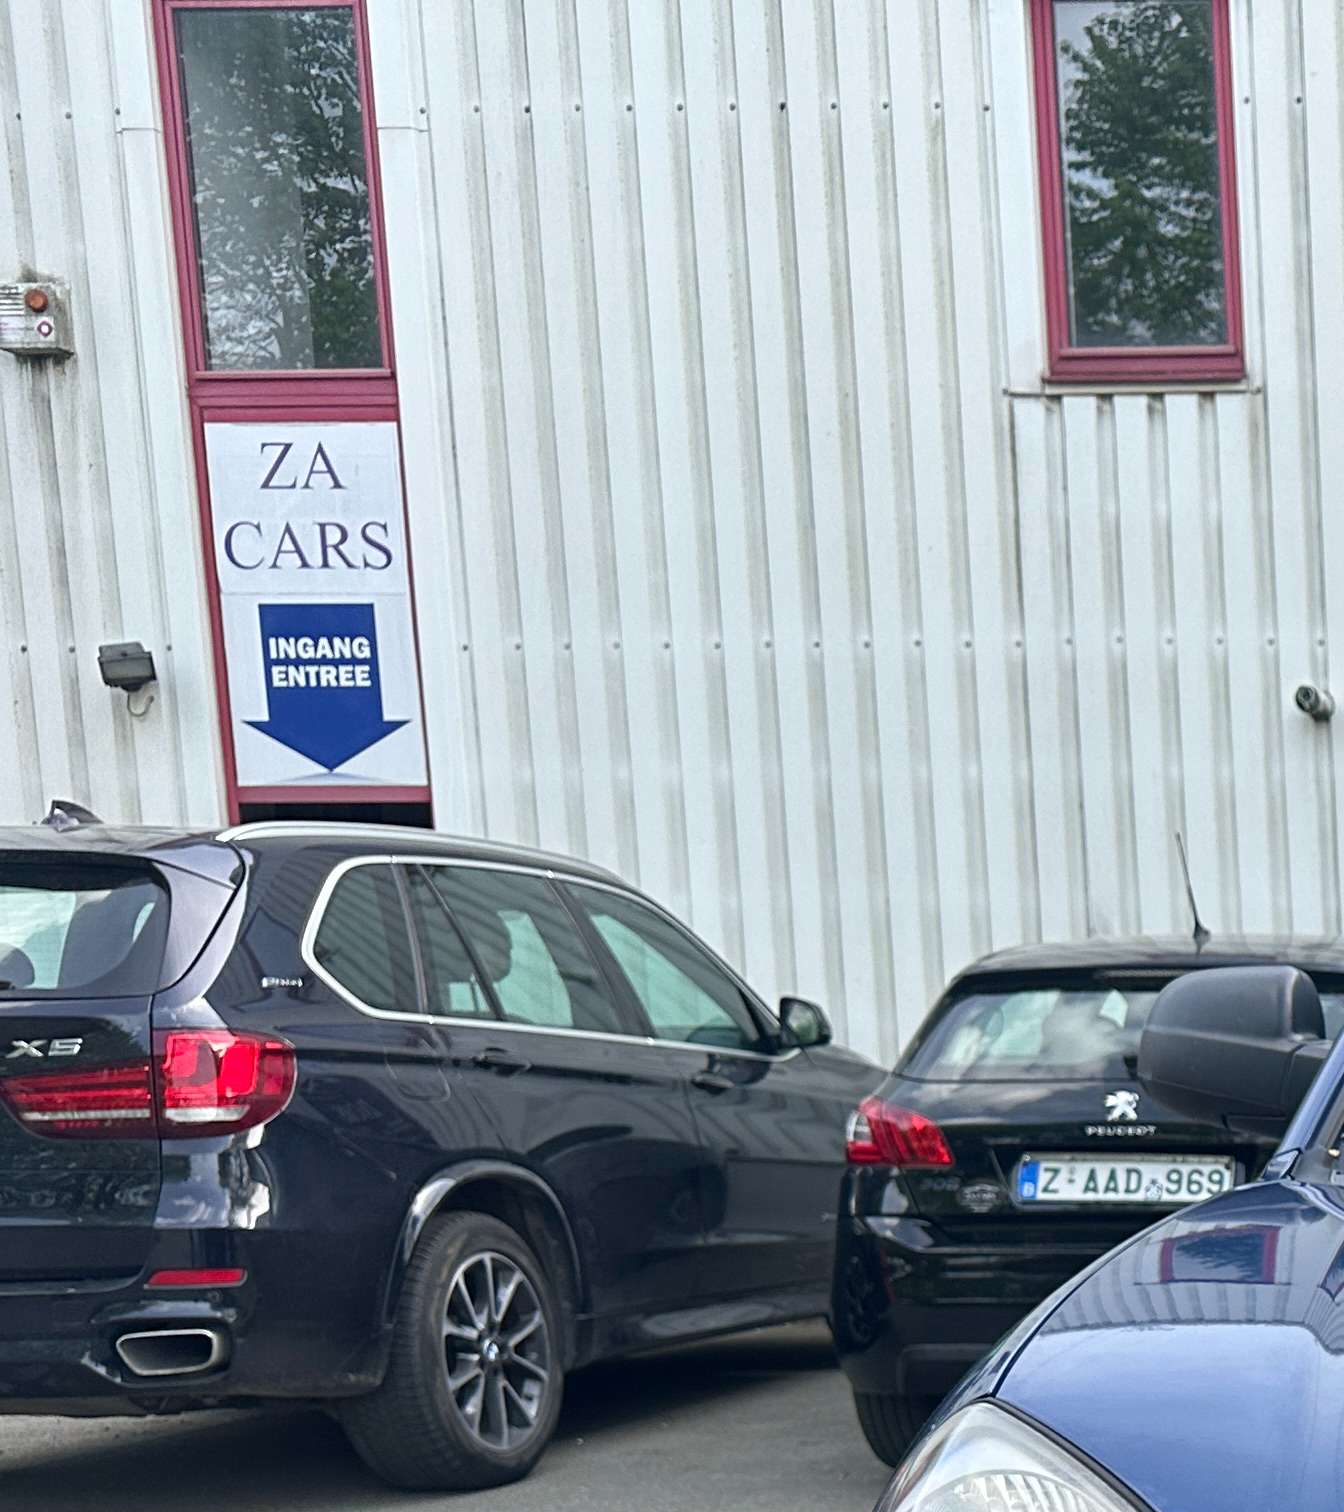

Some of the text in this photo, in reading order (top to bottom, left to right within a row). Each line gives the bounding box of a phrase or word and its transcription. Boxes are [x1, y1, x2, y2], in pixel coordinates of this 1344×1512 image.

[260, 441, 346, 490] ZA
[224, 520, 394, 571] CARS
[268, 636, 371, 660] INGANG
[271, 664, 372, 688] ENTREE
[5, 1038, 83, 1059] X5
